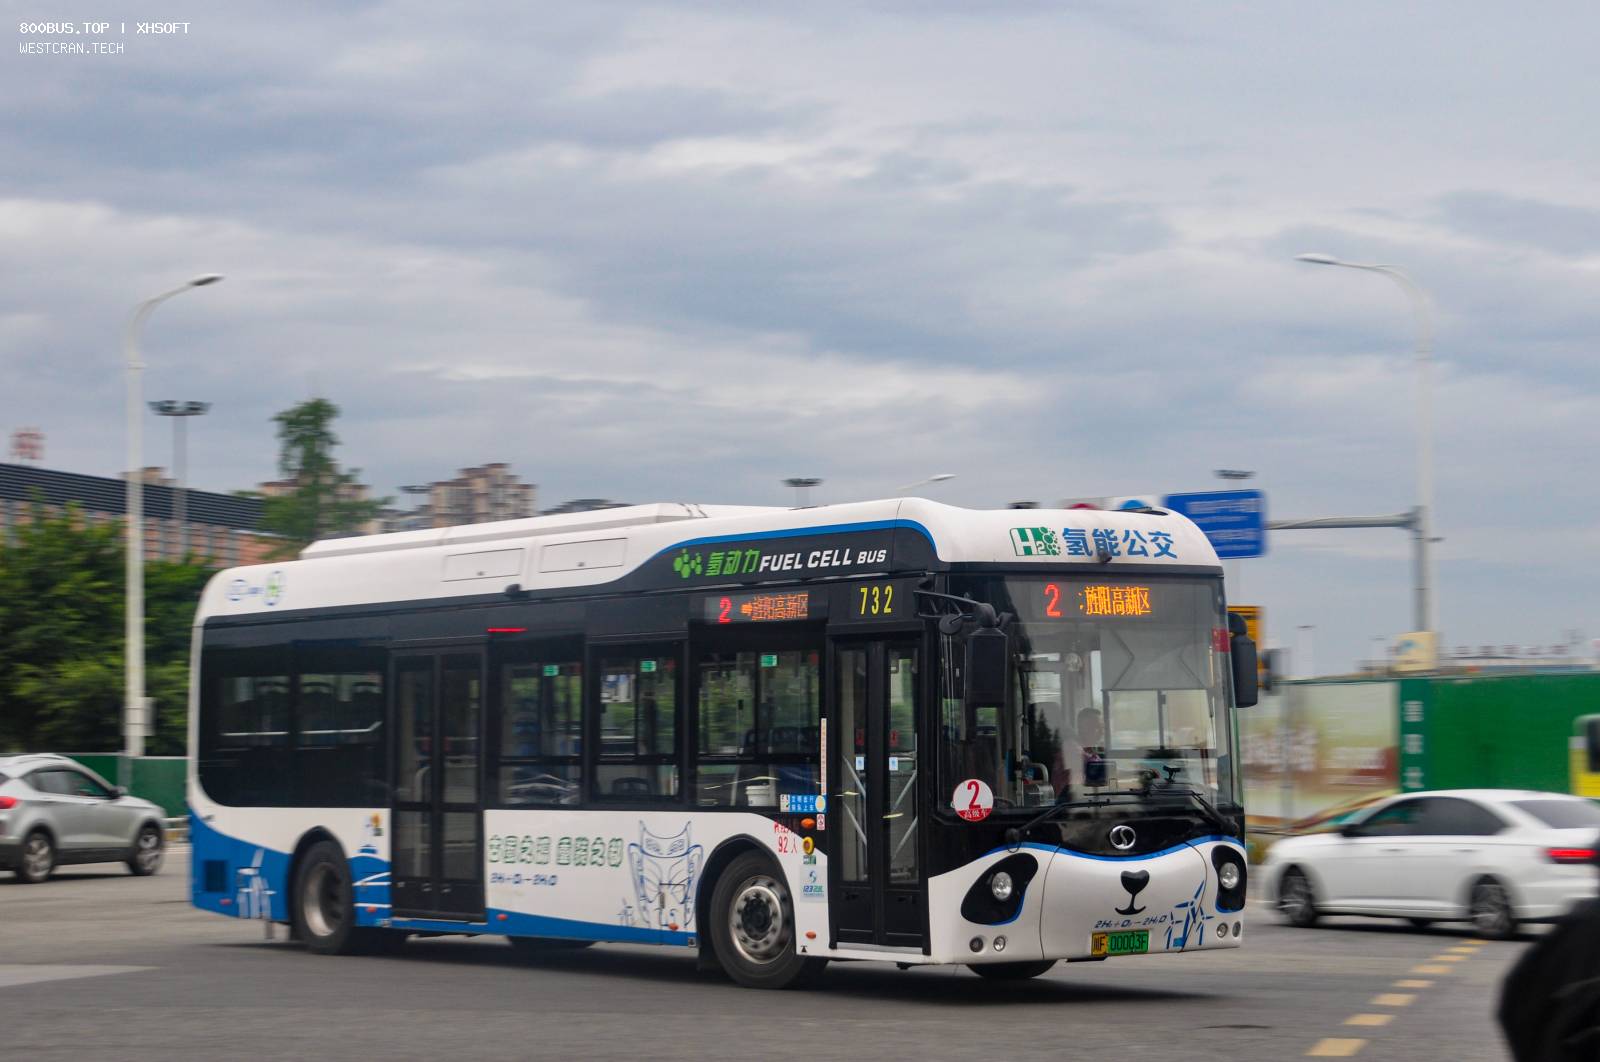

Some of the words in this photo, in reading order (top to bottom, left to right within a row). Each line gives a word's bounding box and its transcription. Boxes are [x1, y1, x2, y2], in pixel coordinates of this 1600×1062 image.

[1062, 527, 1178, 559] 氢能公交
[705, 549, 760, 576] 氢动力
[759, 553, 803, 573] FUEL
[807, 548, 852, 569] CELL
[856, 549, 887, 564] BUS
[718, 596, 732, 624] 2
[860, 585, 893, 615] 732
[1044, 583, 1062, 616] 2
[967, 780, 981, 809] 2
